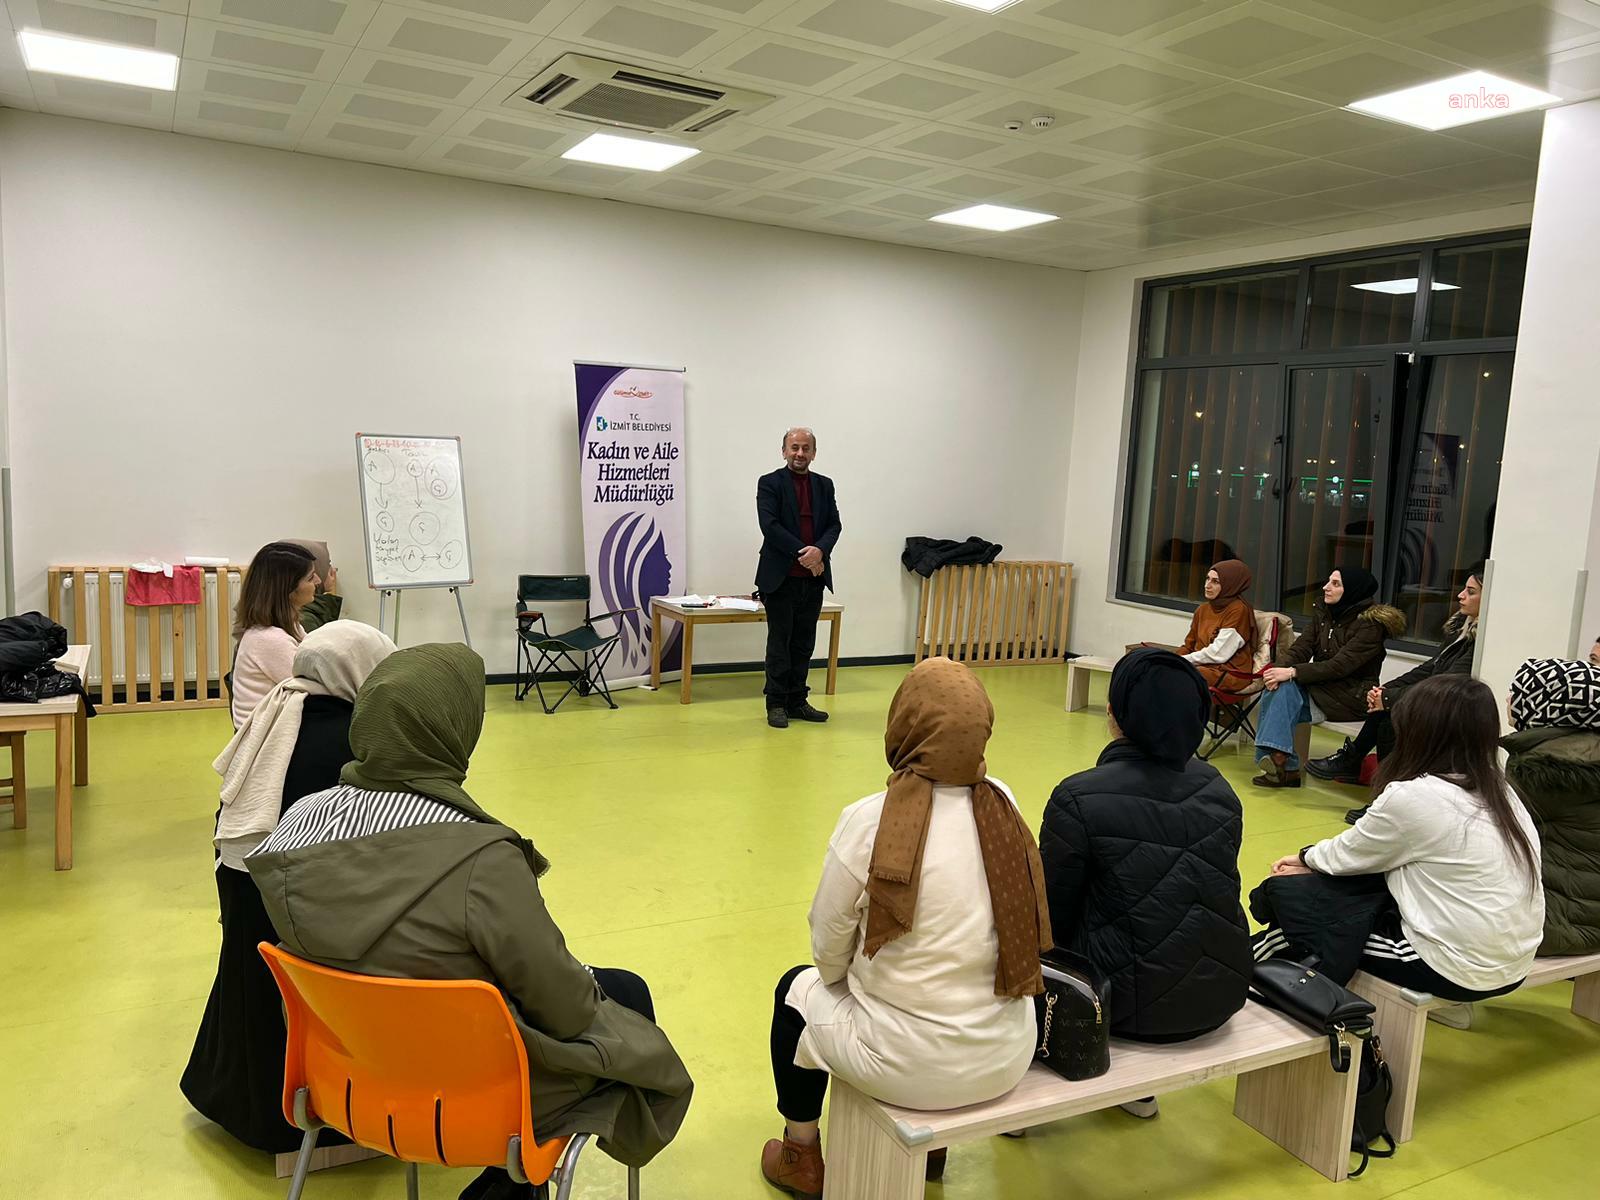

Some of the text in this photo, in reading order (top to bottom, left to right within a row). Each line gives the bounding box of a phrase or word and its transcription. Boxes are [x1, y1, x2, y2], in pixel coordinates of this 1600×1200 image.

[610, 421, 672, 432] İZMİT BELEDİYESİ
[629, 413, 640, 421] T.C.
[587, 440, 679, 460] Kadın ve Aile
[597, 462, 671, 481] Hizmetleri
[593, 483, 674, 506] Müdürlüğü
